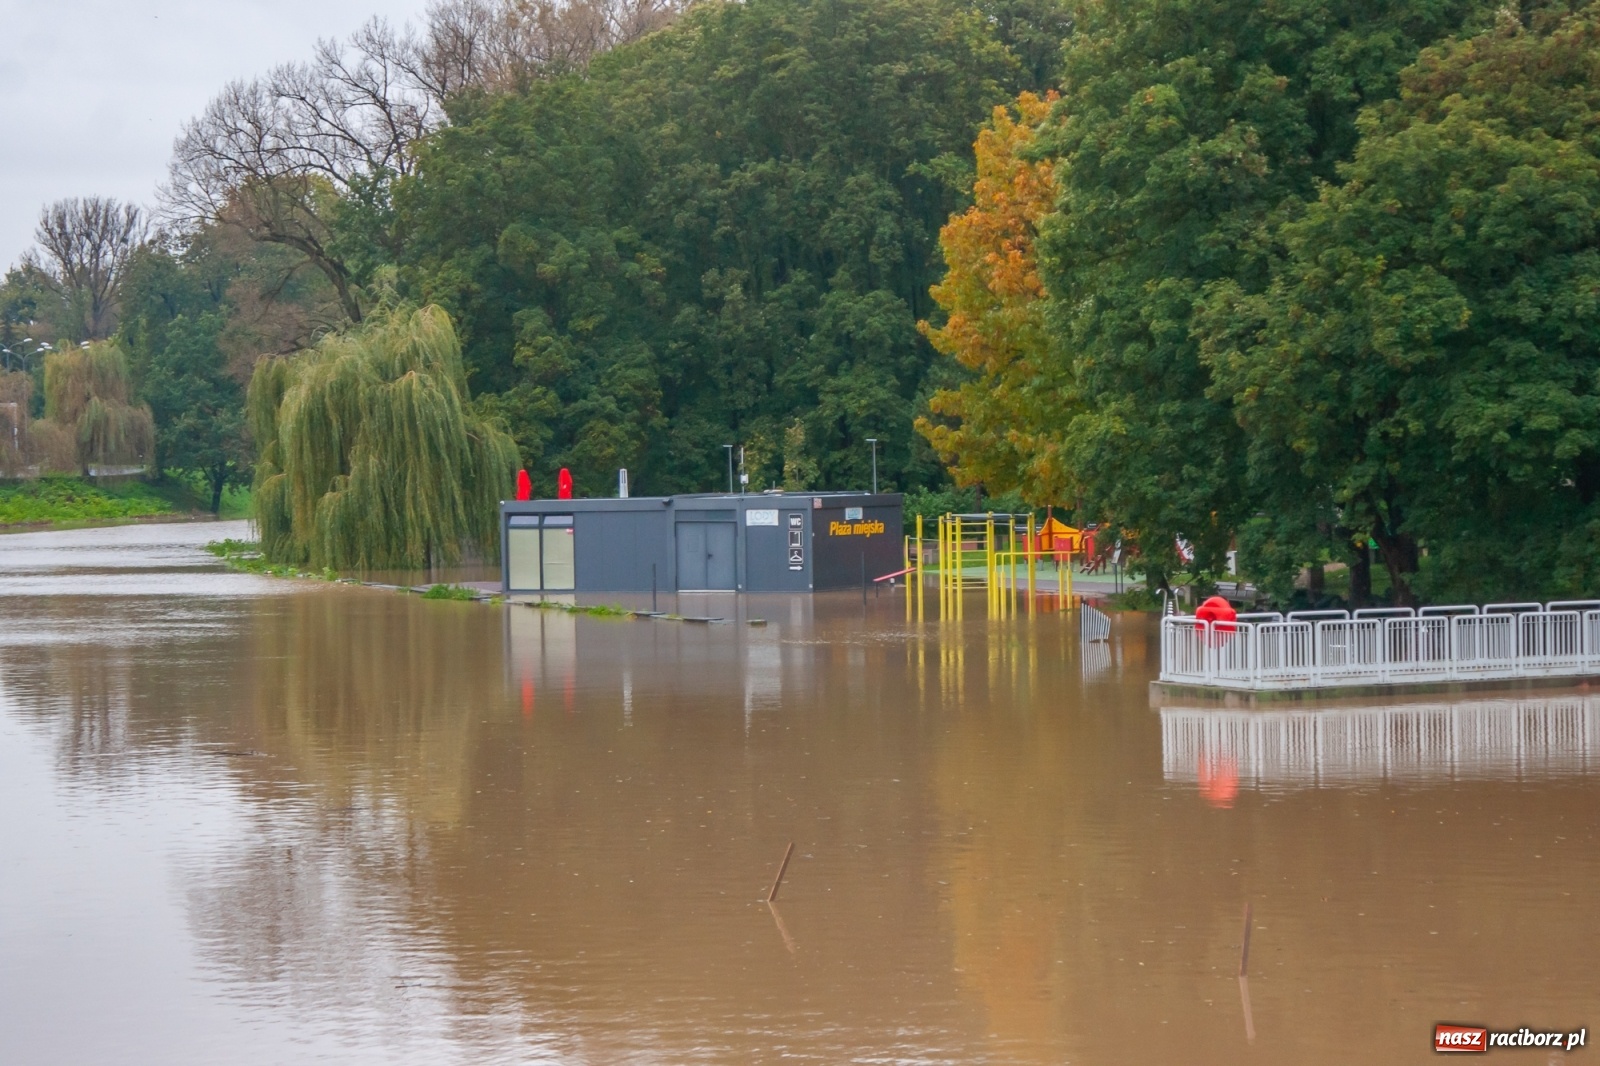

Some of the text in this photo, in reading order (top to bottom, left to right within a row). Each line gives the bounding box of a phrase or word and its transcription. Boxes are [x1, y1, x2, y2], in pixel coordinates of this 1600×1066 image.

[790, 517, 801, 525] WC
[829, 520, 884, 537] Plaża miejska
